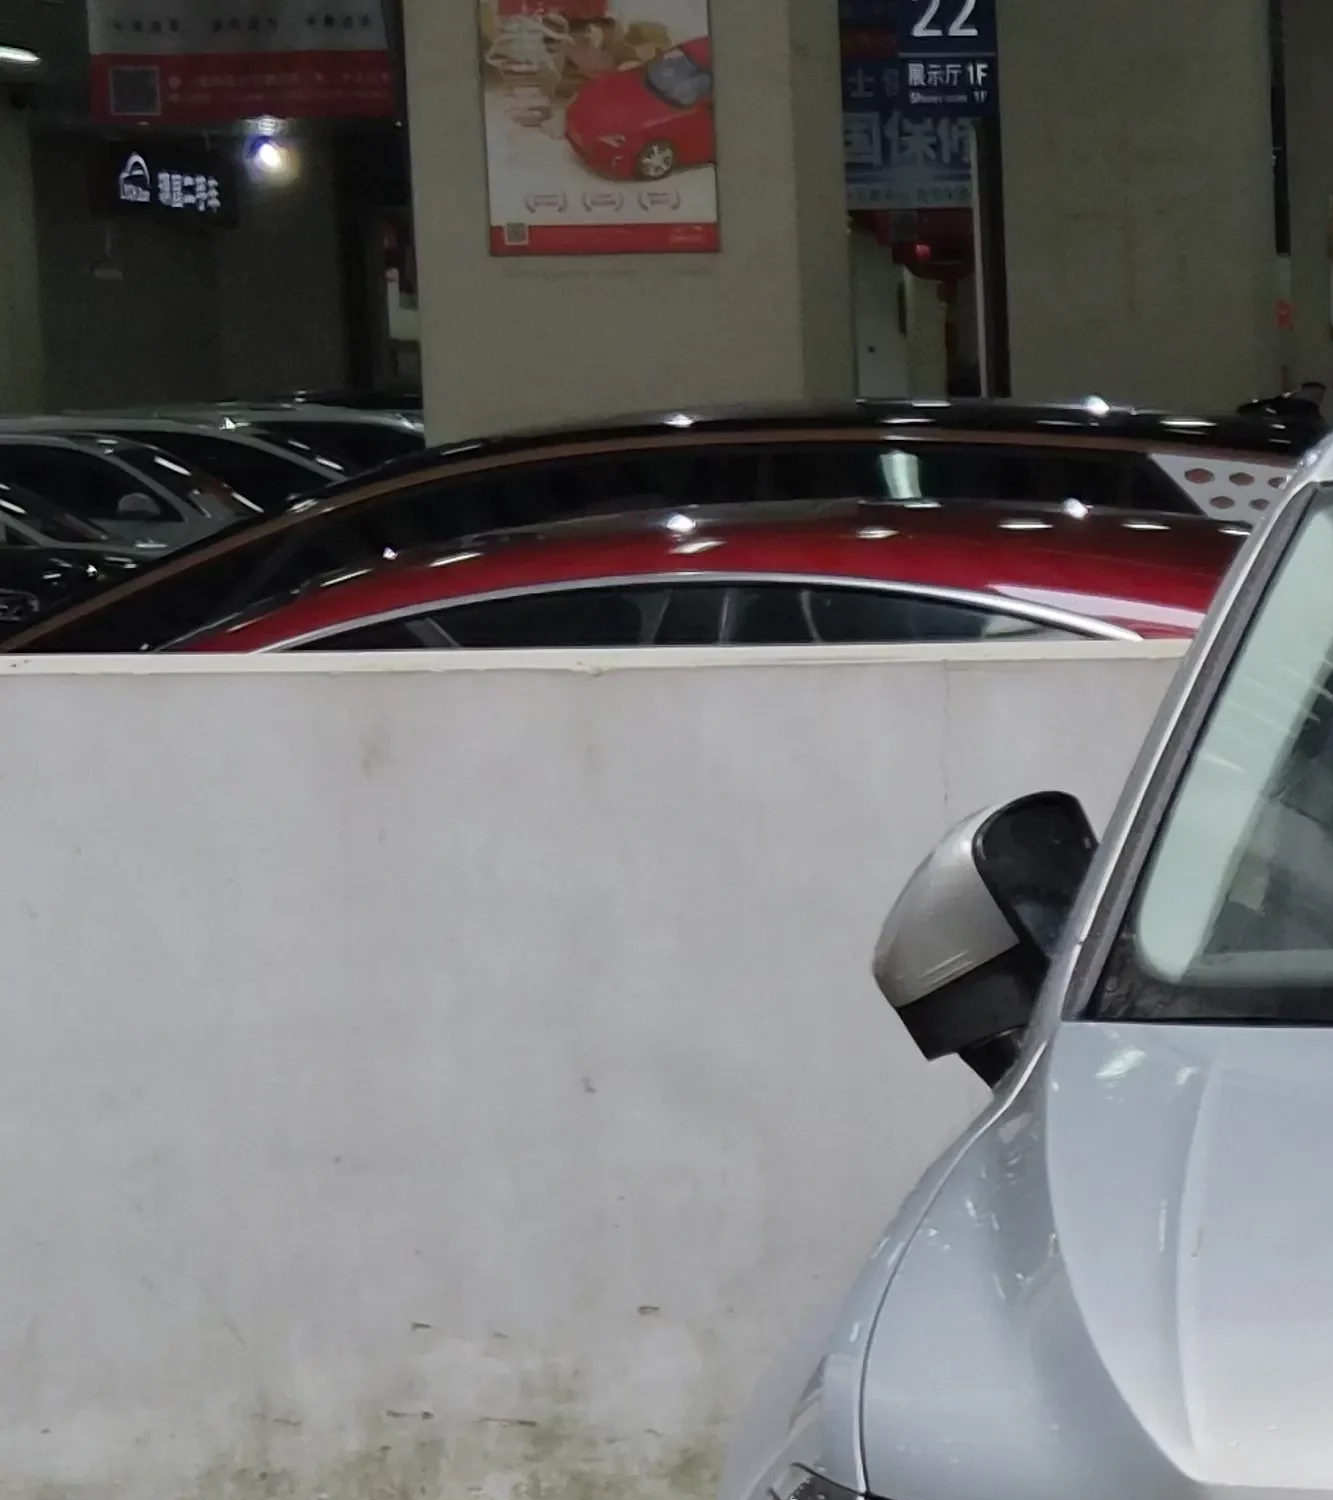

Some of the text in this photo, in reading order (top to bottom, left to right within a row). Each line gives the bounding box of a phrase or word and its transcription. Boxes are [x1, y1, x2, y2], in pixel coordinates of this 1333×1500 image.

[910, 0, 979, 37] 22
[907, 62, 989, 86] 展示厅 1F
